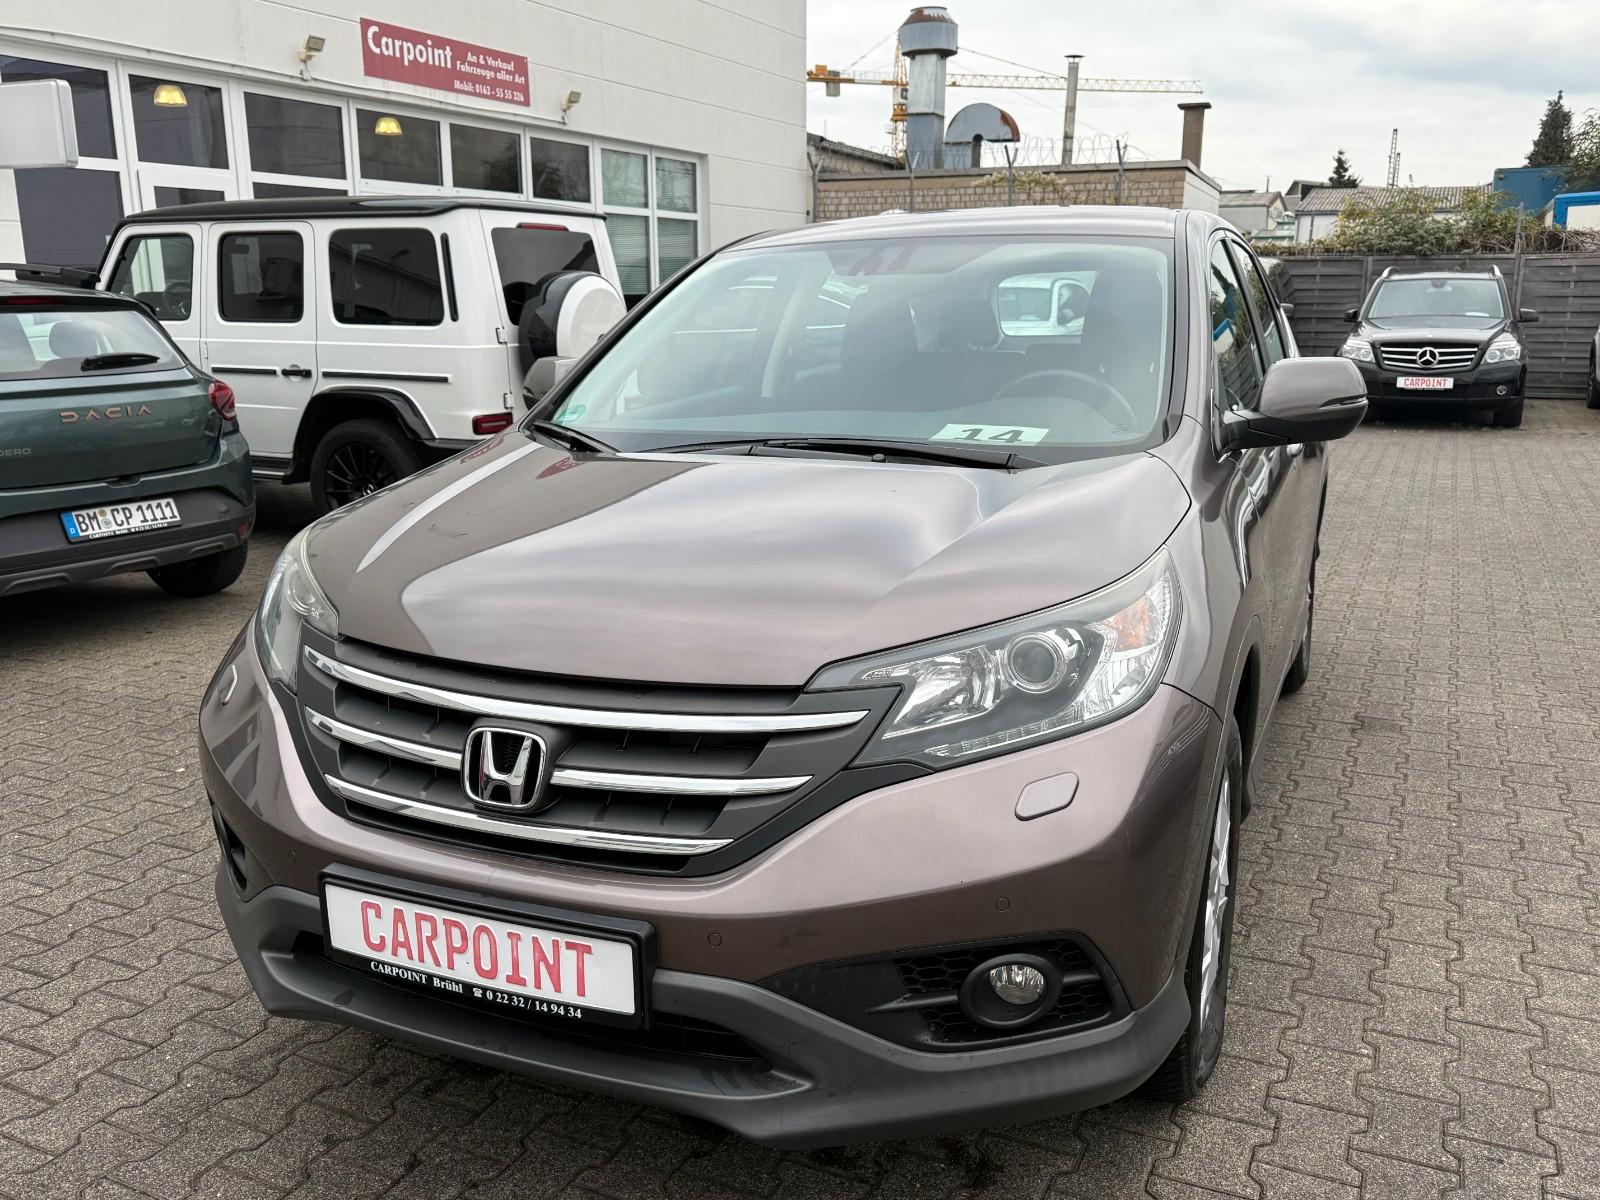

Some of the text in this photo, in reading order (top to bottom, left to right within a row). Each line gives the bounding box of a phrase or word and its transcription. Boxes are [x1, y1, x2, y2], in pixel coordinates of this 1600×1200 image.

[367, 25, 453, 69] Carpoint
[456, 60, 525, 84] Fahrzeuge aller Art
[467, 51, 514, 71] An & Verkauf
[453, 79, 475, 92] Mobil:
[475, 84, 491, 96] 0163
[496, 87, 504, 98] 55
[504, 89, 512, 100] 55
[1404, 378, 1447, 387] CARPOINT
[60, 404, 152, 423] DACIA
[953, 428, 1024, 443] 14
[75, 511, 102, 533] BM
[110, 506, 133, 527] CP
[136, 500, 177, 524] 1111
[360, 898, 594, 998] CARPOINT
[370, 960, 582, 1019] CARPOINT Brühl 0 22 32 / 14 94 34
